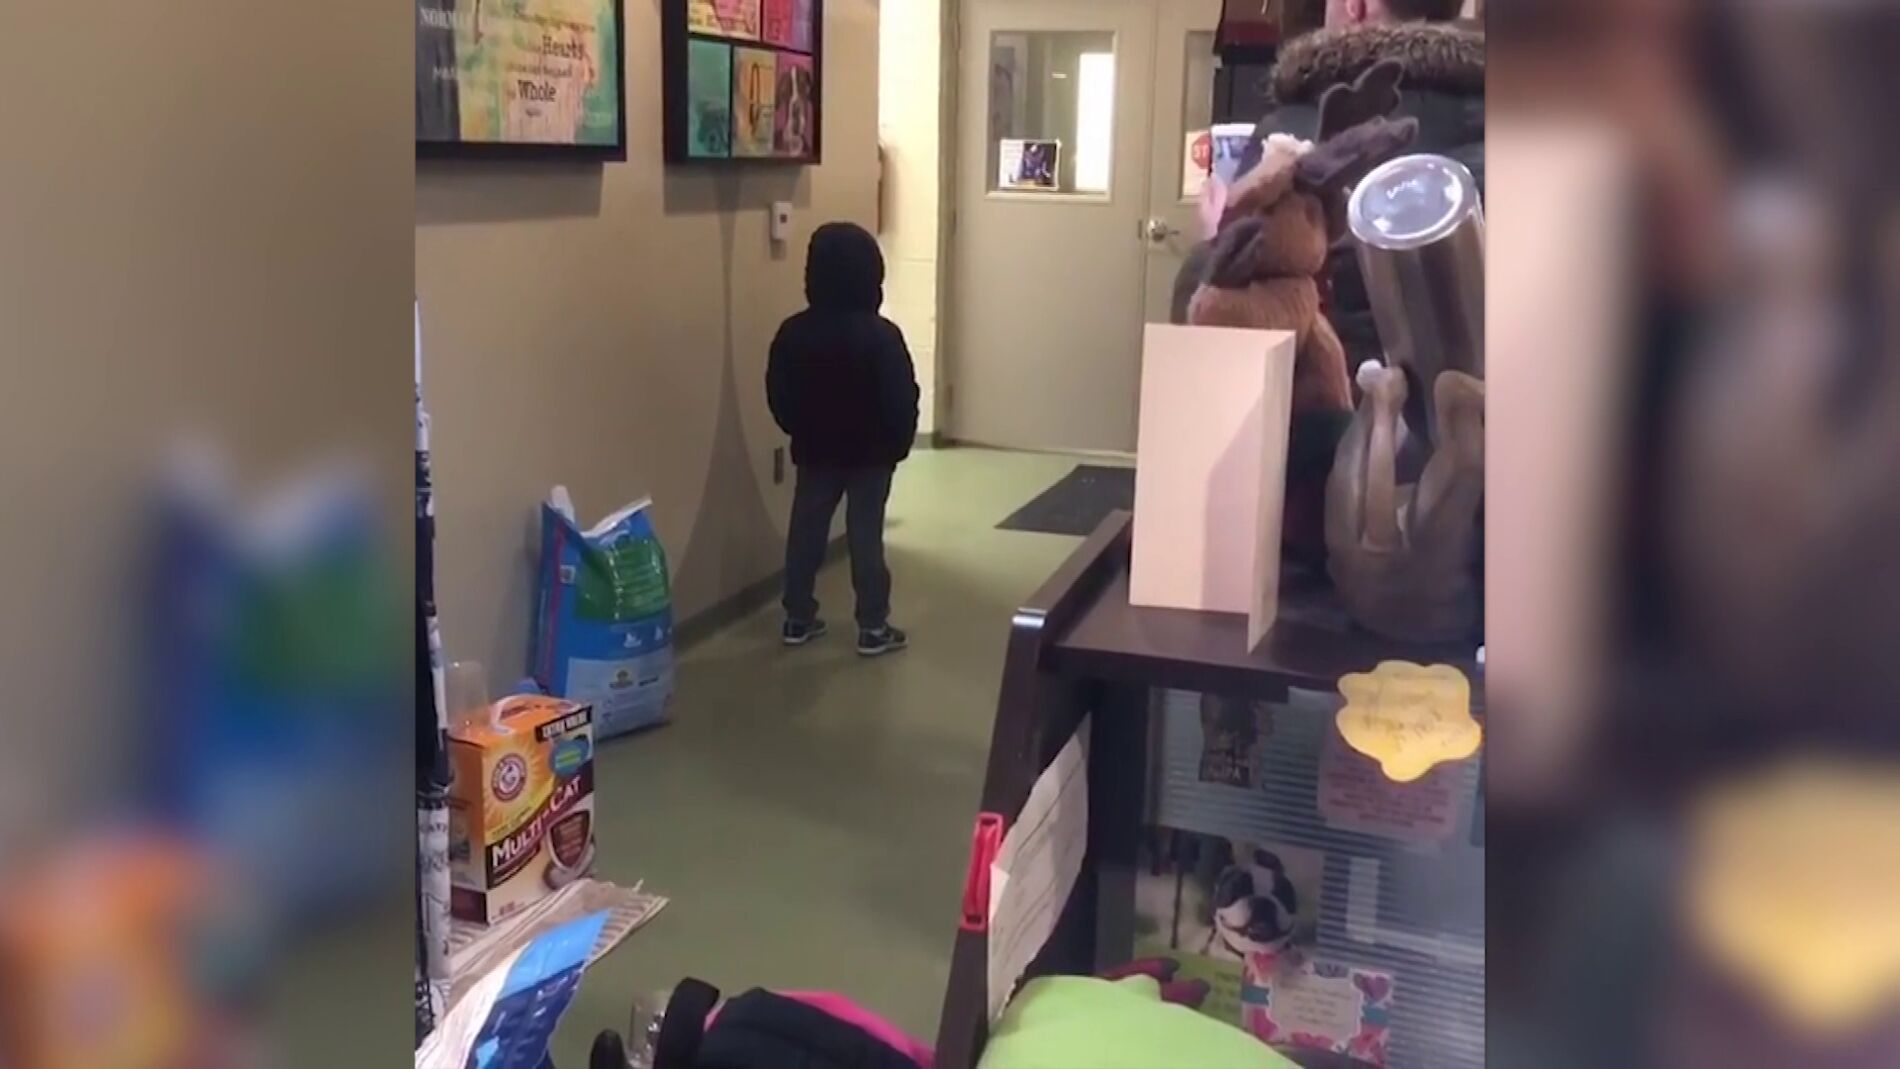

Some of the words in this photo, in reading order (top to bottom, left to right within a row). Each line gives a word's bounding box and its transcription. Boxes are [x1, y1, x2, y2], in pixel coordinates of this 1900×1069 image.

[542, 34, 584, 60] Hearts
[517, 79, 557, 102] Whole
[492, 775, 581, 868] MULTI-CAT
